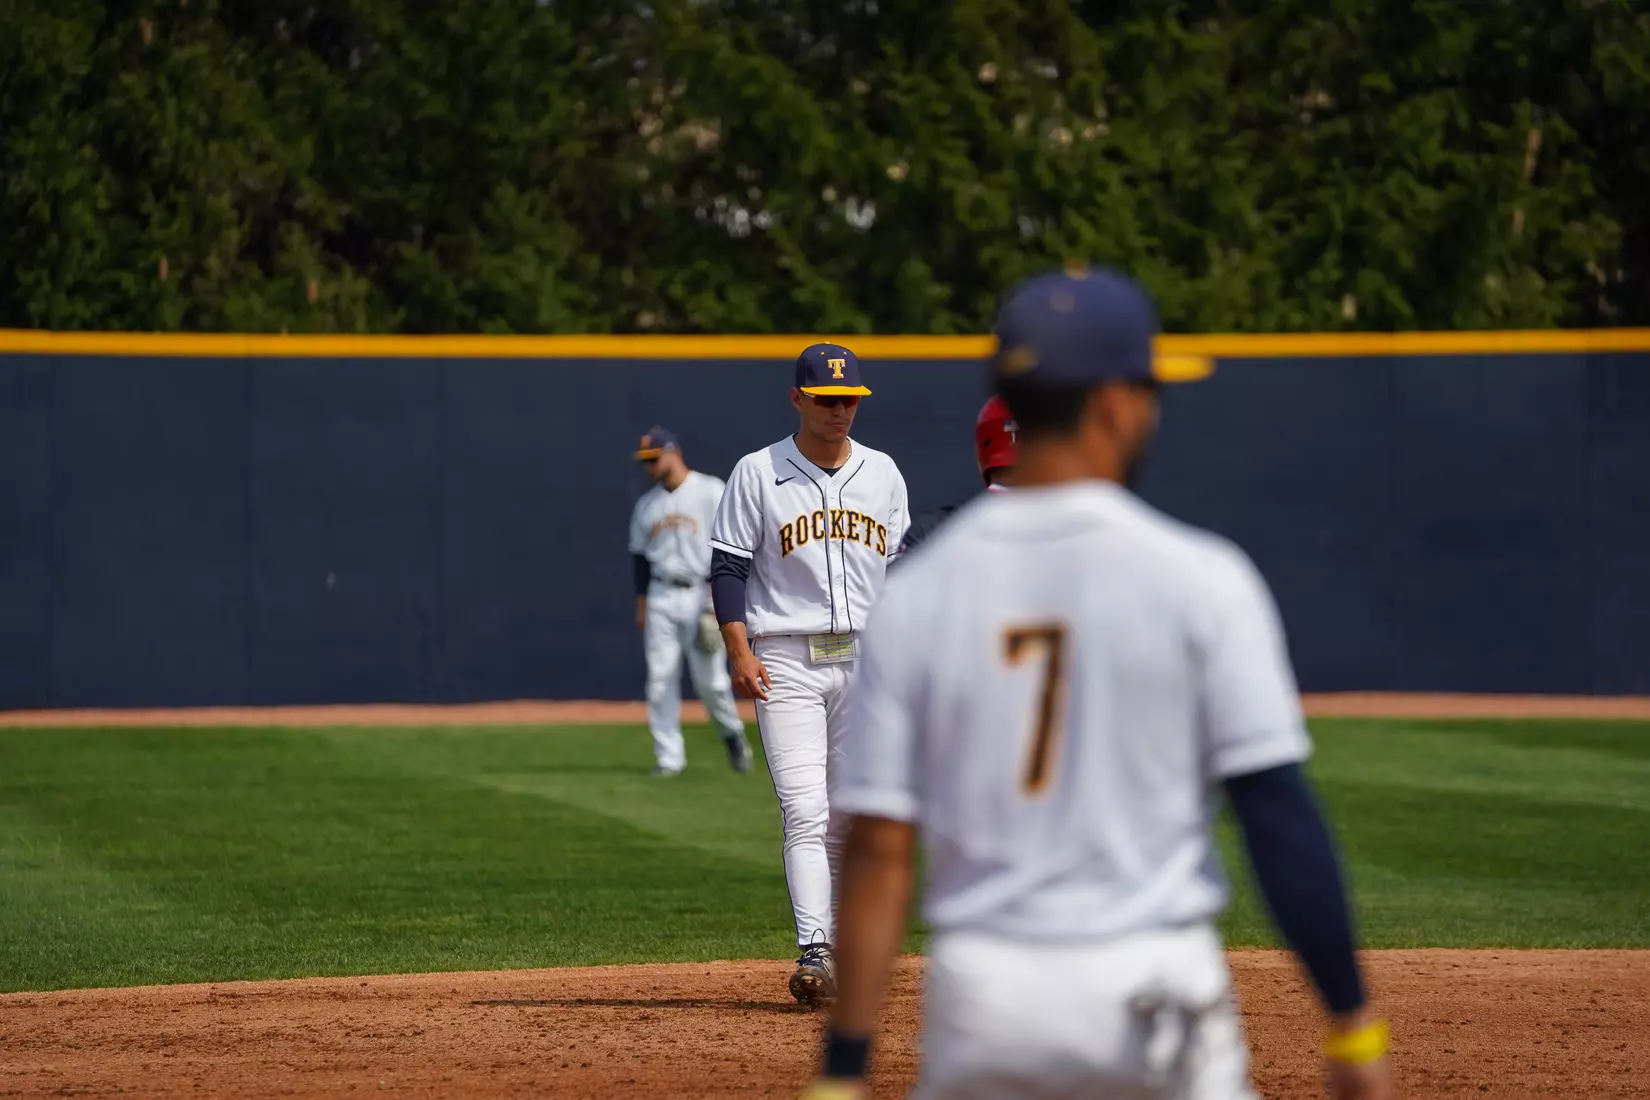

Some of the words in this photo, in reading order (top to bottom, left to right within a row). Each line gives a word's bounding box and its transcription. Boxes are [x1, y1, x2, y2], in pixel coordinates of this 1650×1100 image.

[827, 359, 846, 378] T
[778, 508, 887, 559] ROCKETS
[1001, 621, 1070, 797] 7
